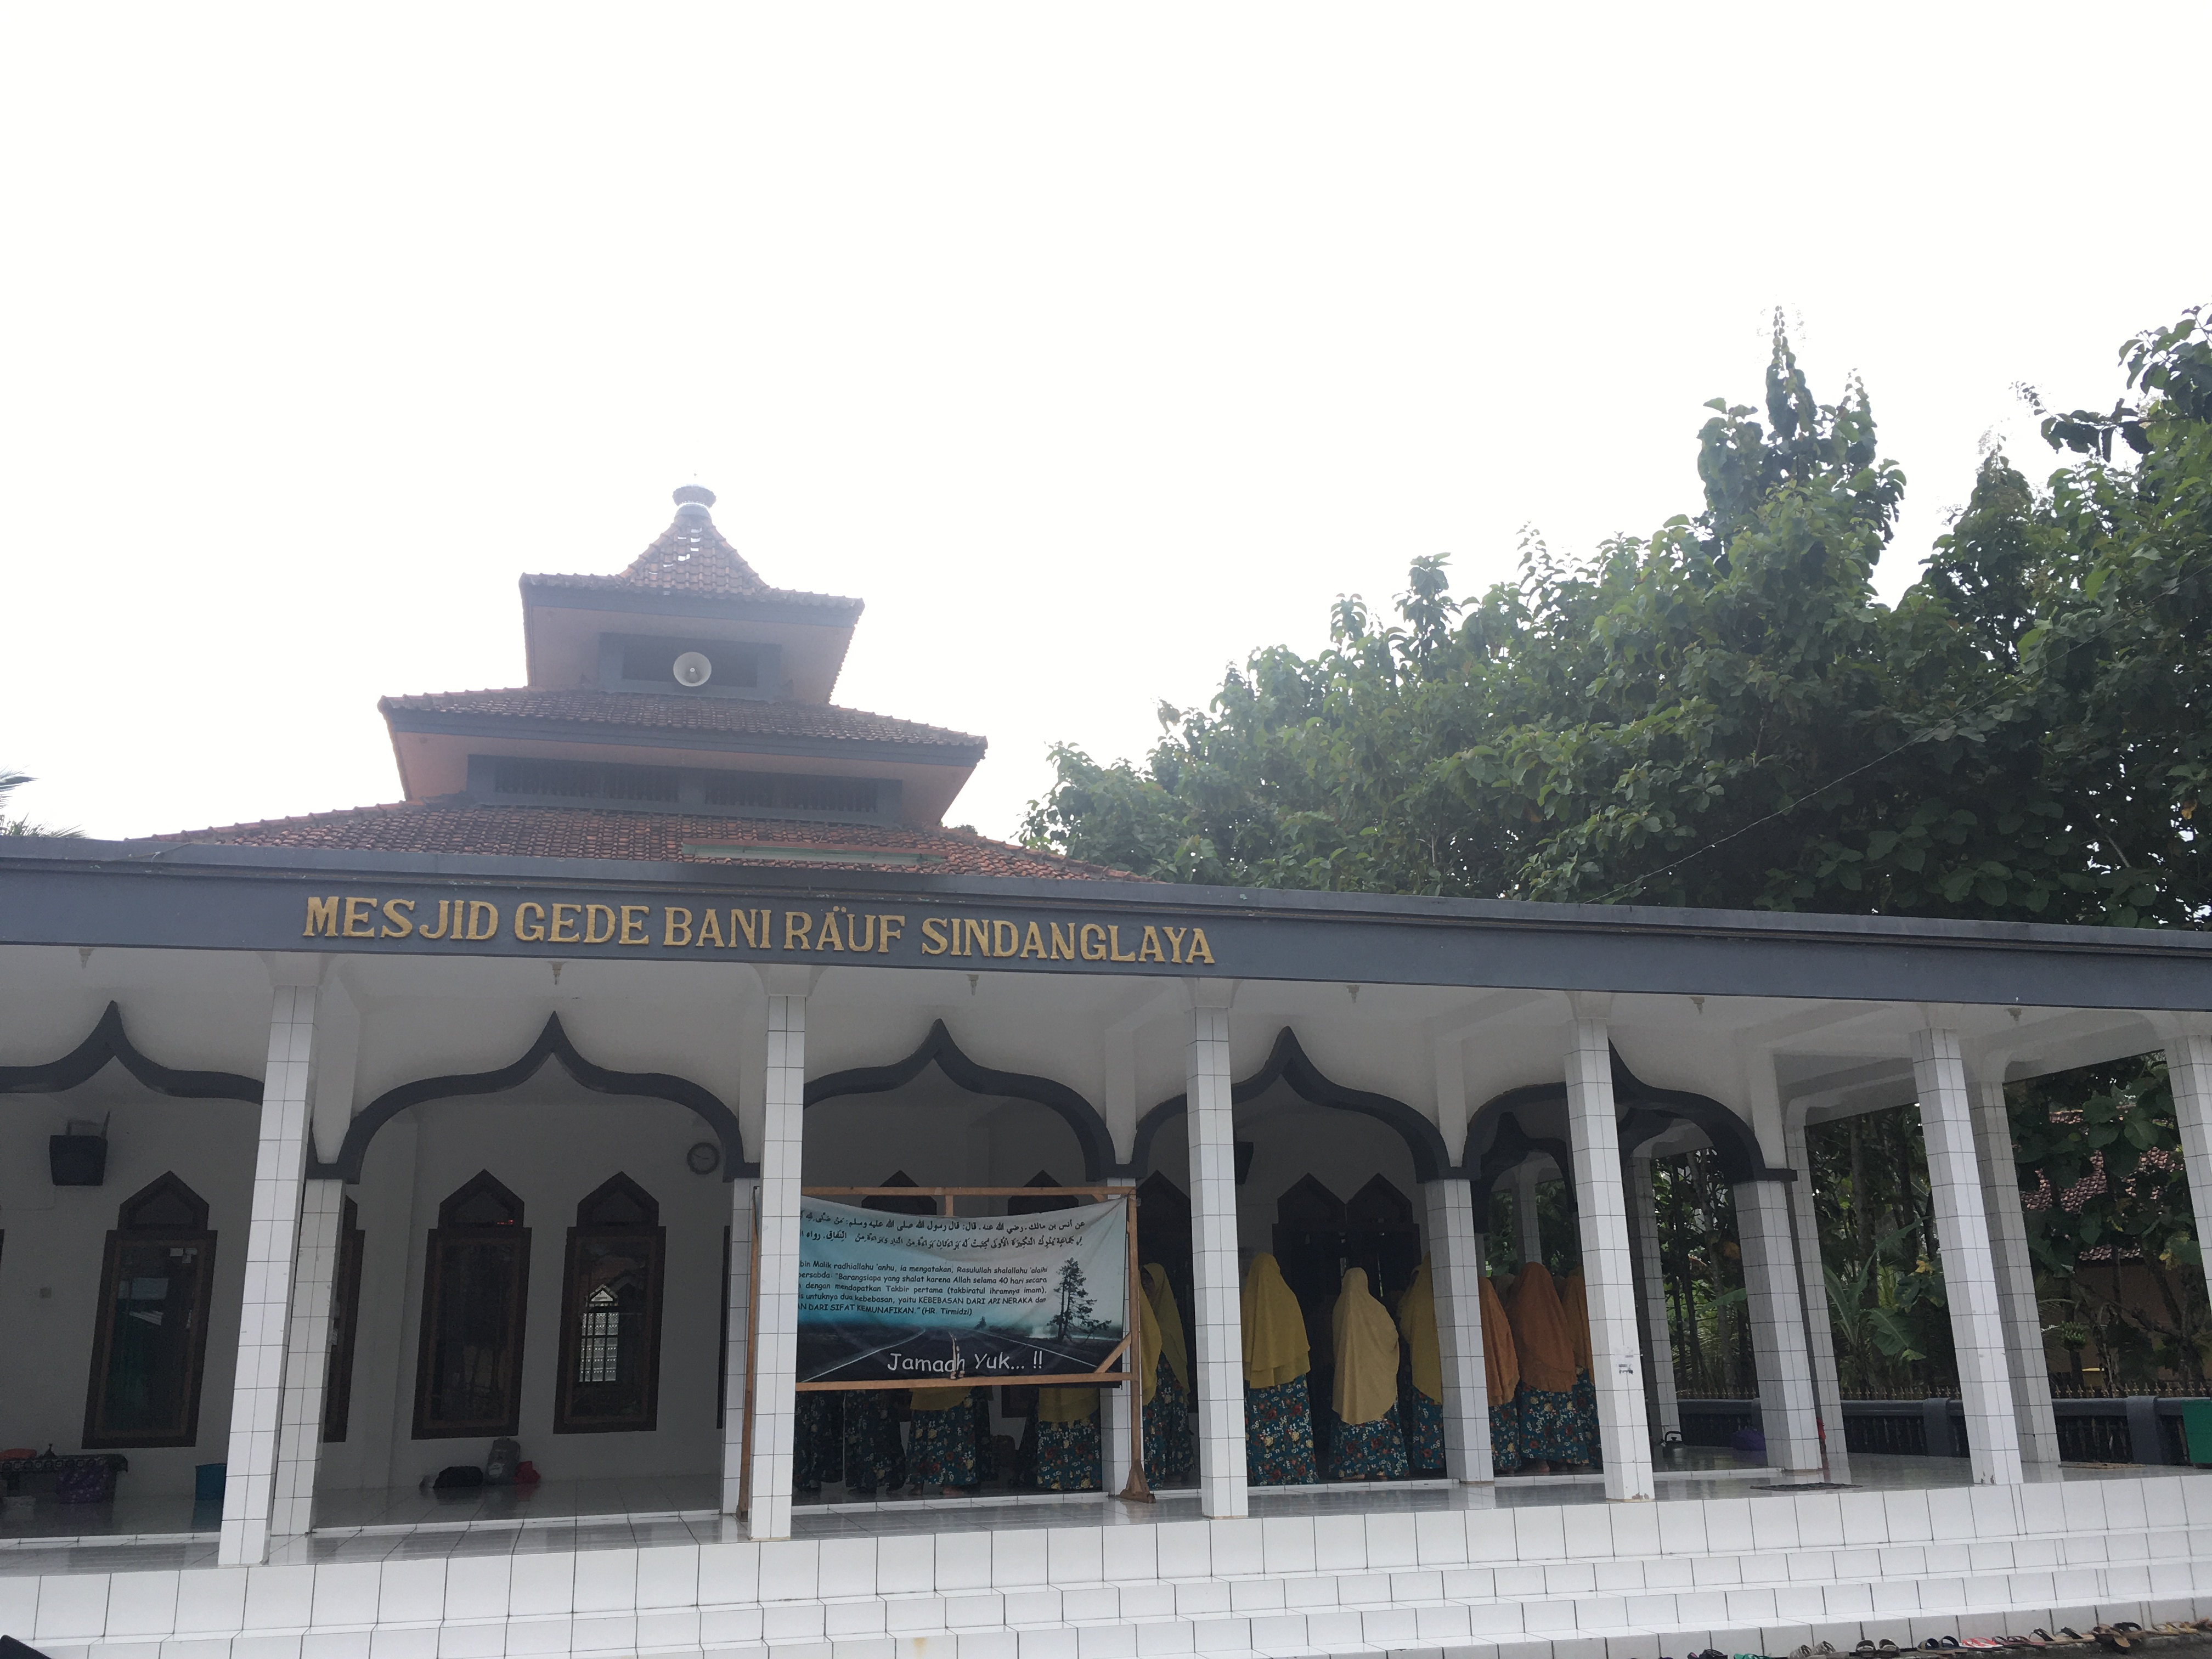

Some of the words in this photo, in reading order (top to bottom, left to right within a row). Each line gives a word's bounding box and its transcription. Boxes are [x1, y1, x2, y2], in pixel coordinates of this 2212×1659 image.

[302, 896, 498, 940] MESJID
[514, 902, 650, 946] GEDE
[663, 906, 771, 949] BANI
[921, 916, 1216, 964] SINDANGLAYA
[1075, 1221, 1085, 1229] عن
[833, 1262, 873, 1271] radhiallahu
[909, 1266, 953, 1274] mengatakan,
[835, 1272, 881, 1282] "Barangsiapa
[805, 1282, 831, 1290] dengan
[835, 1284, 881, 1293] mendapatkan
[990, 1287, 1019, 1295] ihramnya
[806, 1293, 838, 1301] untuknya
[855, 1294, 895, 1304] kebebasan,
[940, 1307, 972, 1316] Tirmidzi)
[887, 1353, 965, 1372] Jamaah
[974, 1352, 1025, 1369] Yuk...
[1032, 1350, 1042, 1369] !!
